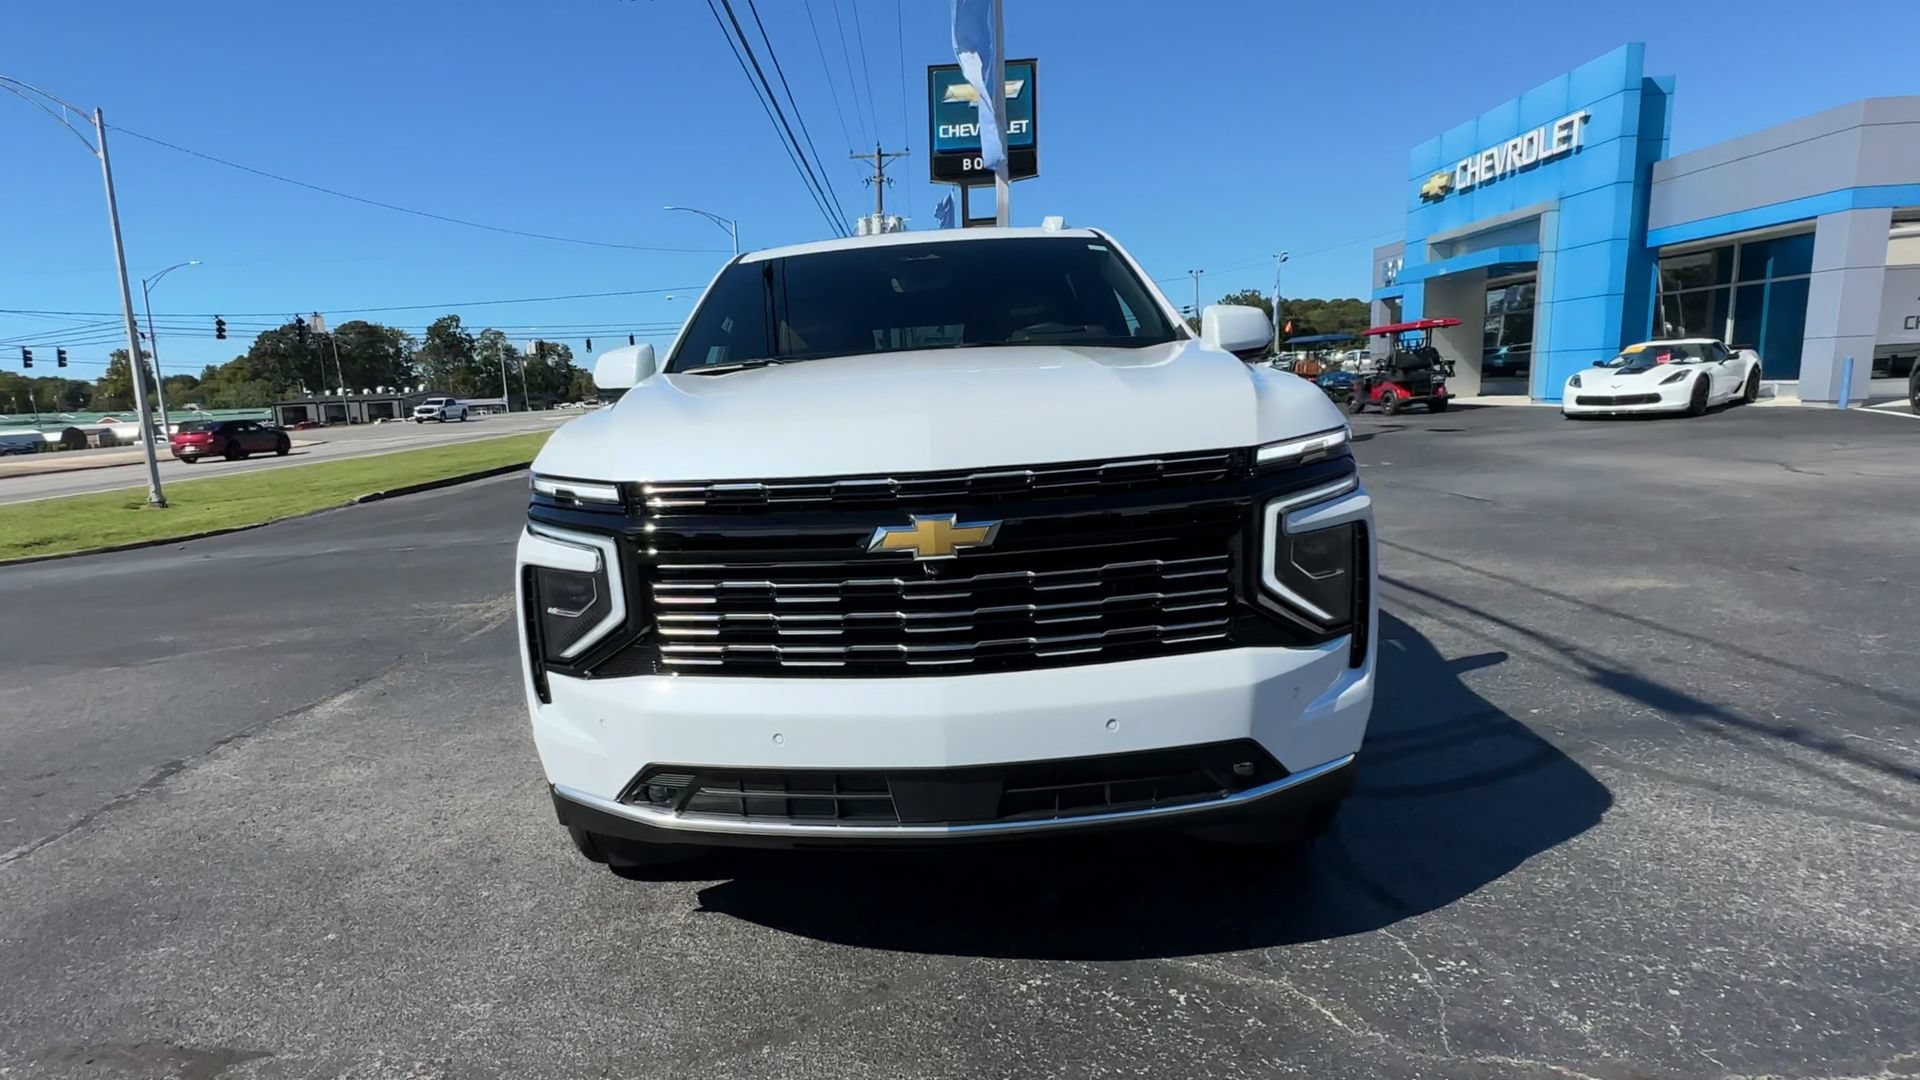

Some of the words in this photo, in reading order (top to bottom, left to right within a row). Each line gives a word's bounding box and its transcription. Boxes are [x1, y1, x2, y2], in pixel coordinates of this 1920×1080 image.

[939, 120, 1029, 138] CHEVET
[1455, 110, 1588, 190] CHEVROLET
[962, 158, 983, 170] BO
